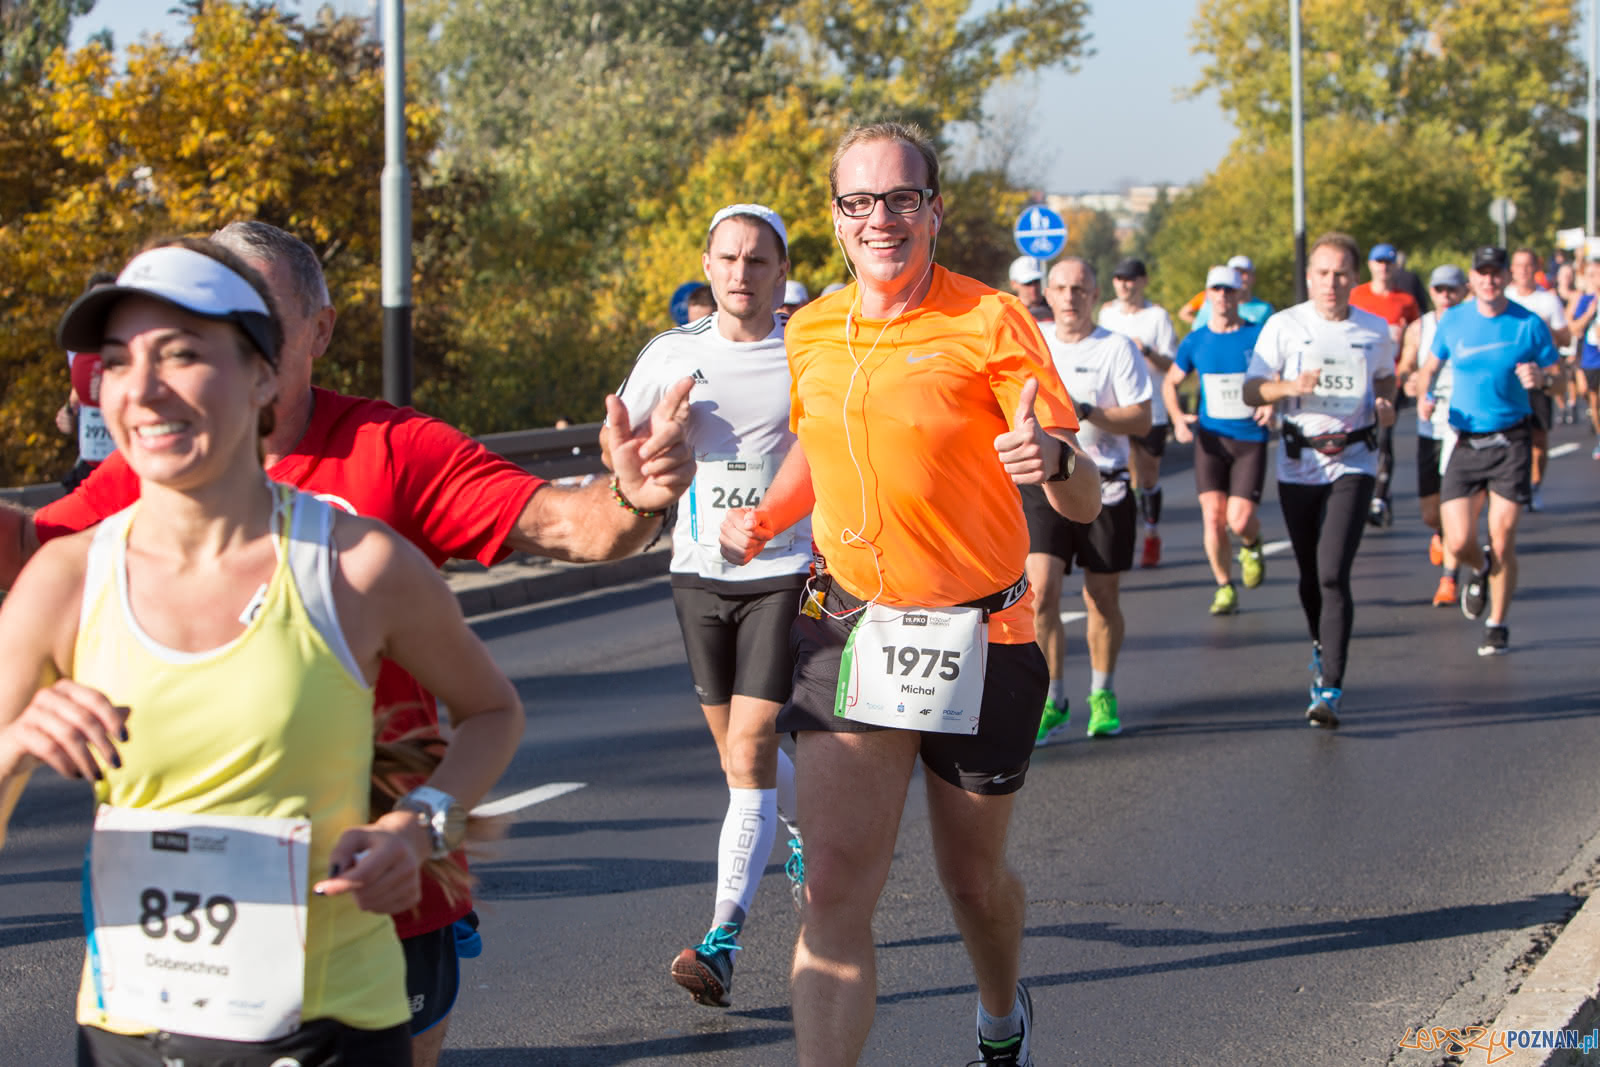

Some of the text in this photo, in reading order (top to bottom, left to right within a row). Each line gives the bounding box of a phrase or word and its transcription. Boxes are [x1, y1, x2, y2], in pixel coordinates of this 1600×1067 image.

[711, 486, 768, 509] 264
[882, 645, 961, 681] 1975
[900, 684, 936, 696] Michał
[140, 887, 238, 946] 839
[145, 952, 230, 977] Dobrochna
